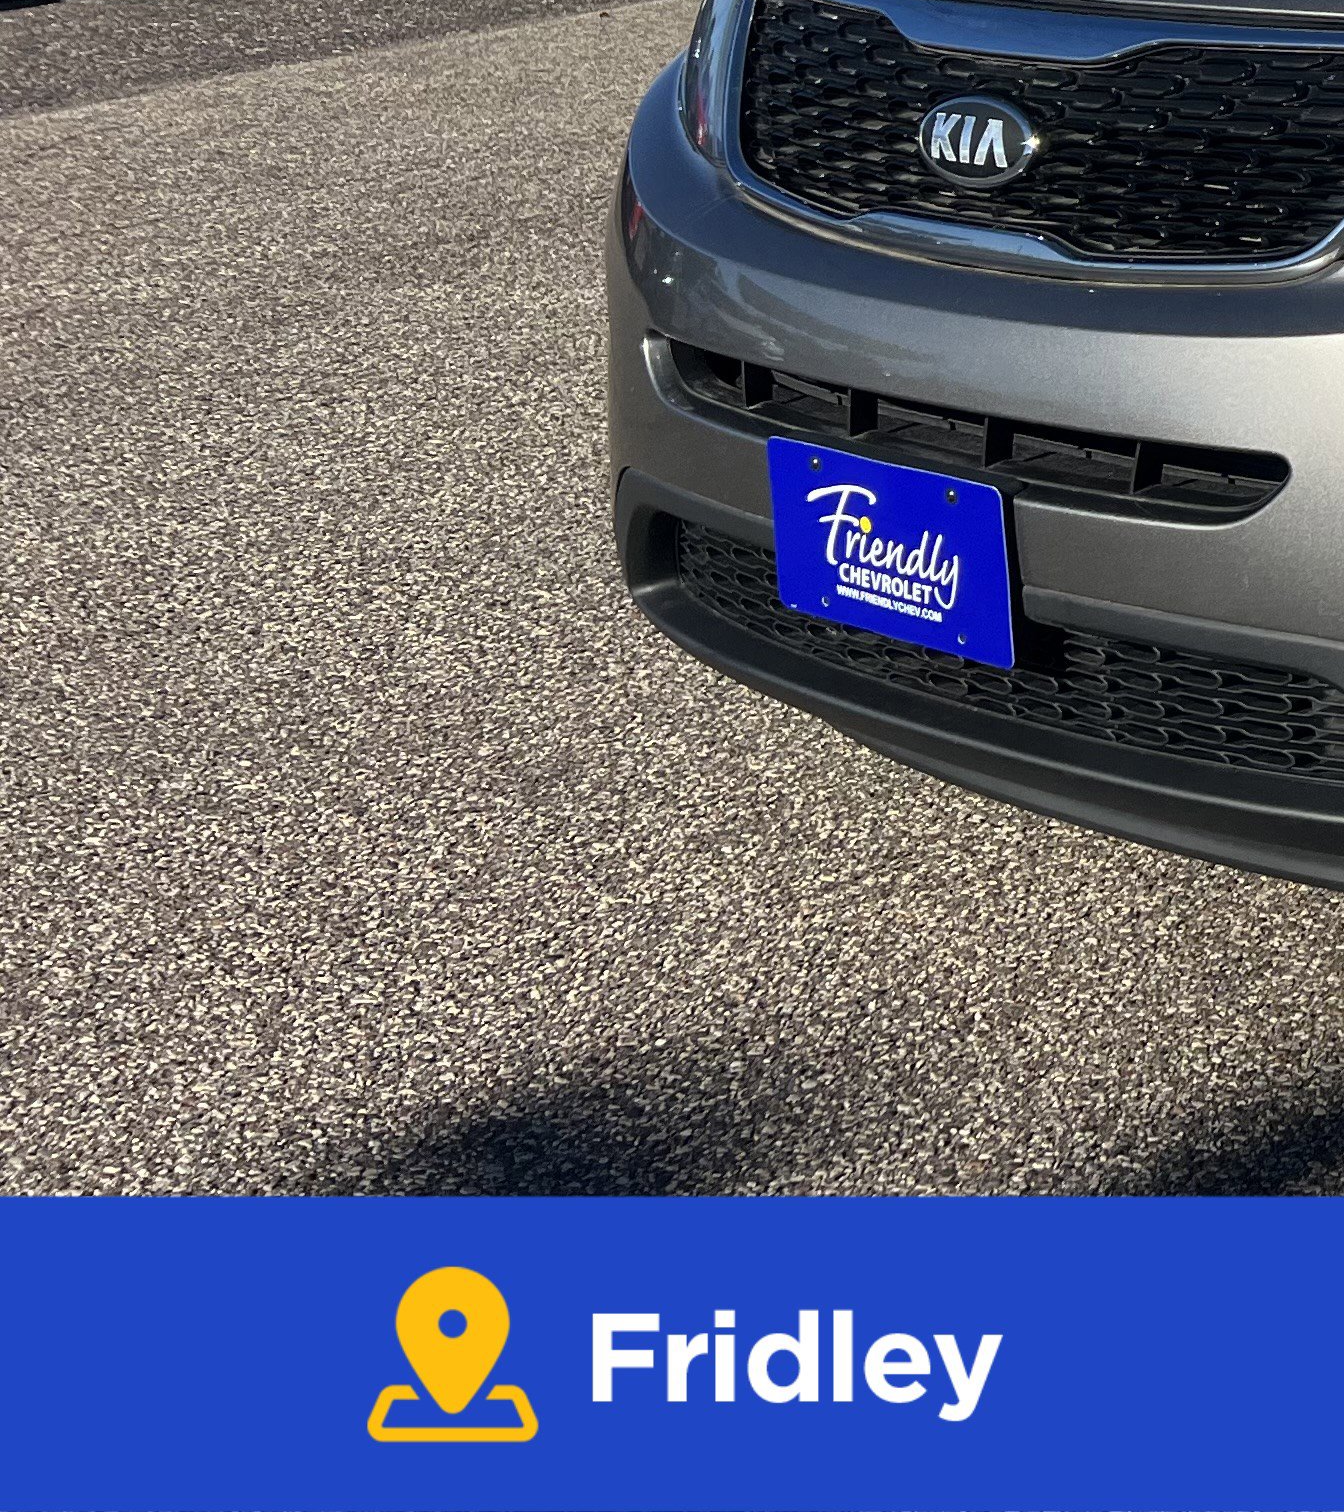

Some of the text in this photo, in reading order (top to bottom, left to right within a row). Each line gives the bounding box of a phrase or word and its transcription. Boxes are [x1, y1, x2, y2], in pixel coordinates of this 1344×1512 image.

[930, 112, 1008, 168] KIA
[806, 484, 959, 610] Friendly
[836, 584, 943, 623] WWW.FRIENDLYCHEV.COM
[838, 562, 933, 605] CHEVROLET
